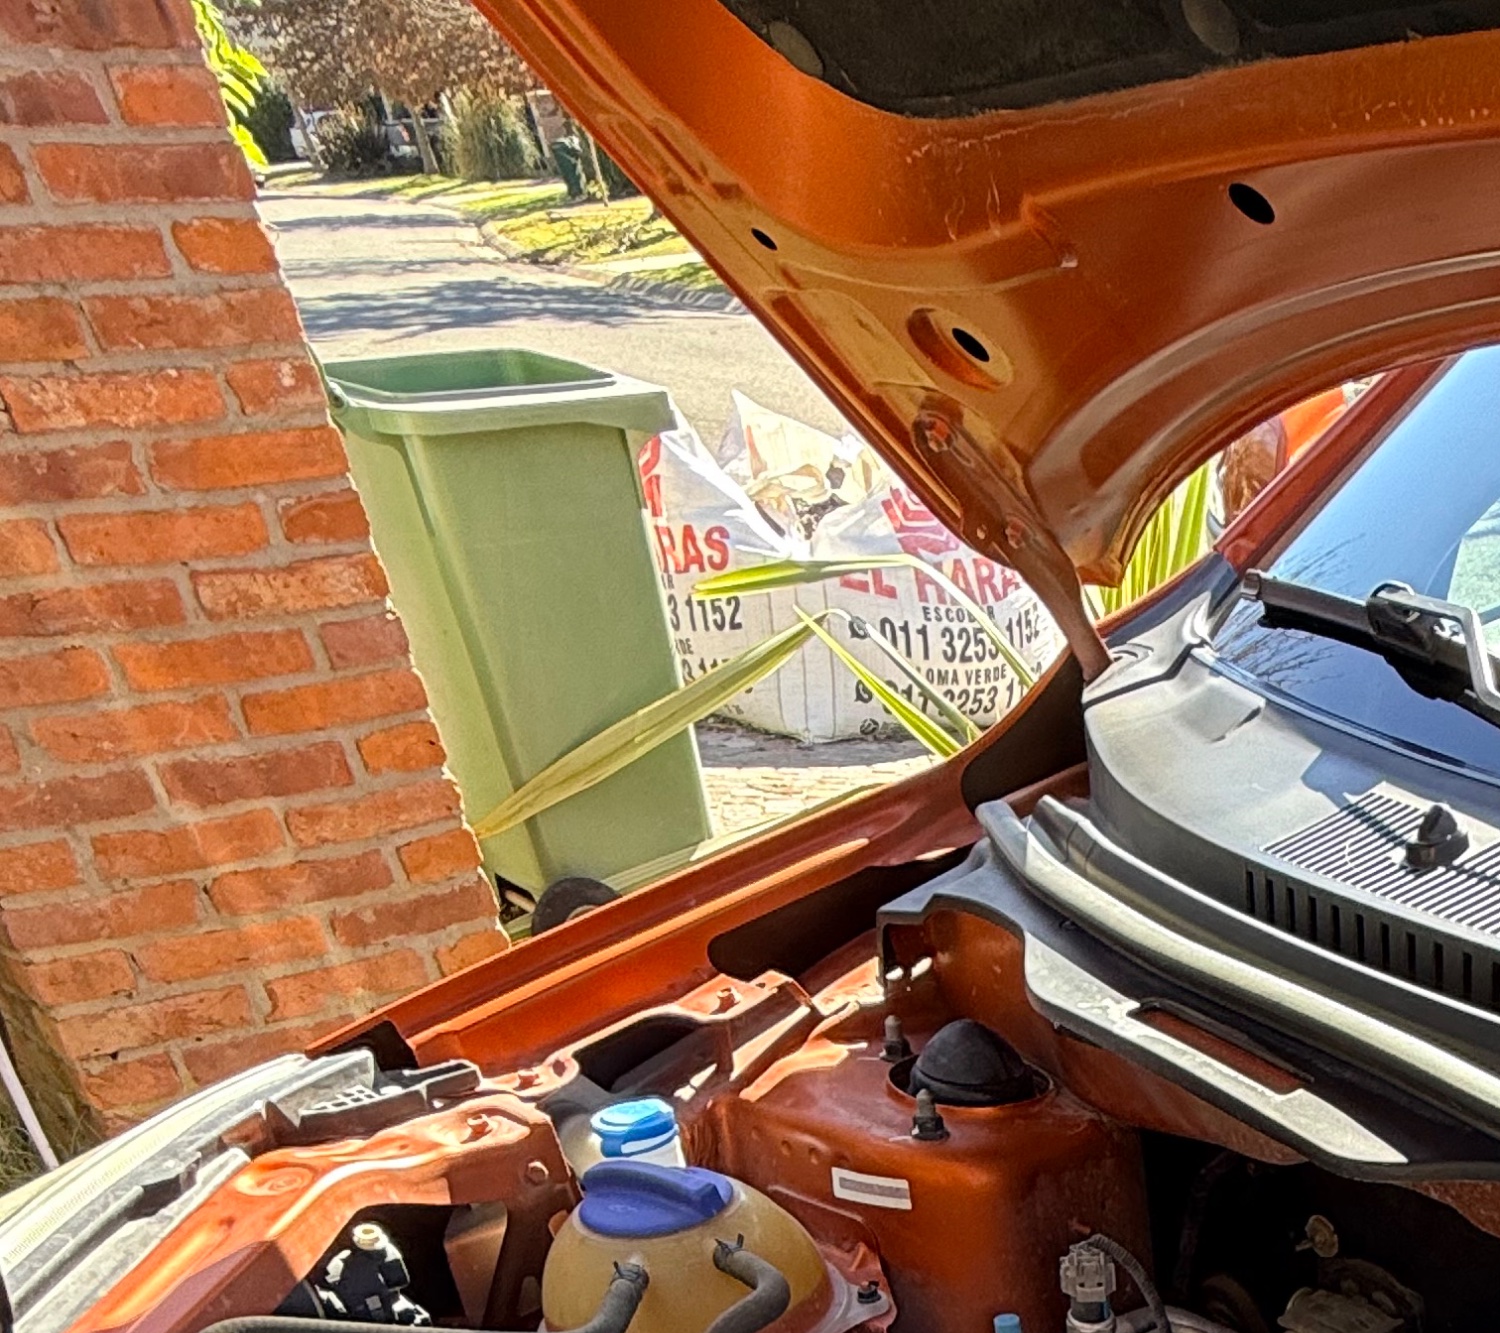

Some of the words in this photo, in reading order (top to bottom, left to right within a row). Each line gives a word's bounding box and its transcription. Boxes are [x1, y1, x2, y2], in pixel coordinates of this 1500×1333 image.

[914, 557, 1021, 605] HARA
[941, 626, 999, 663] 3253
[916, 664, 960, 686] OMA
[965, 663, 1007, 685] VERDE
